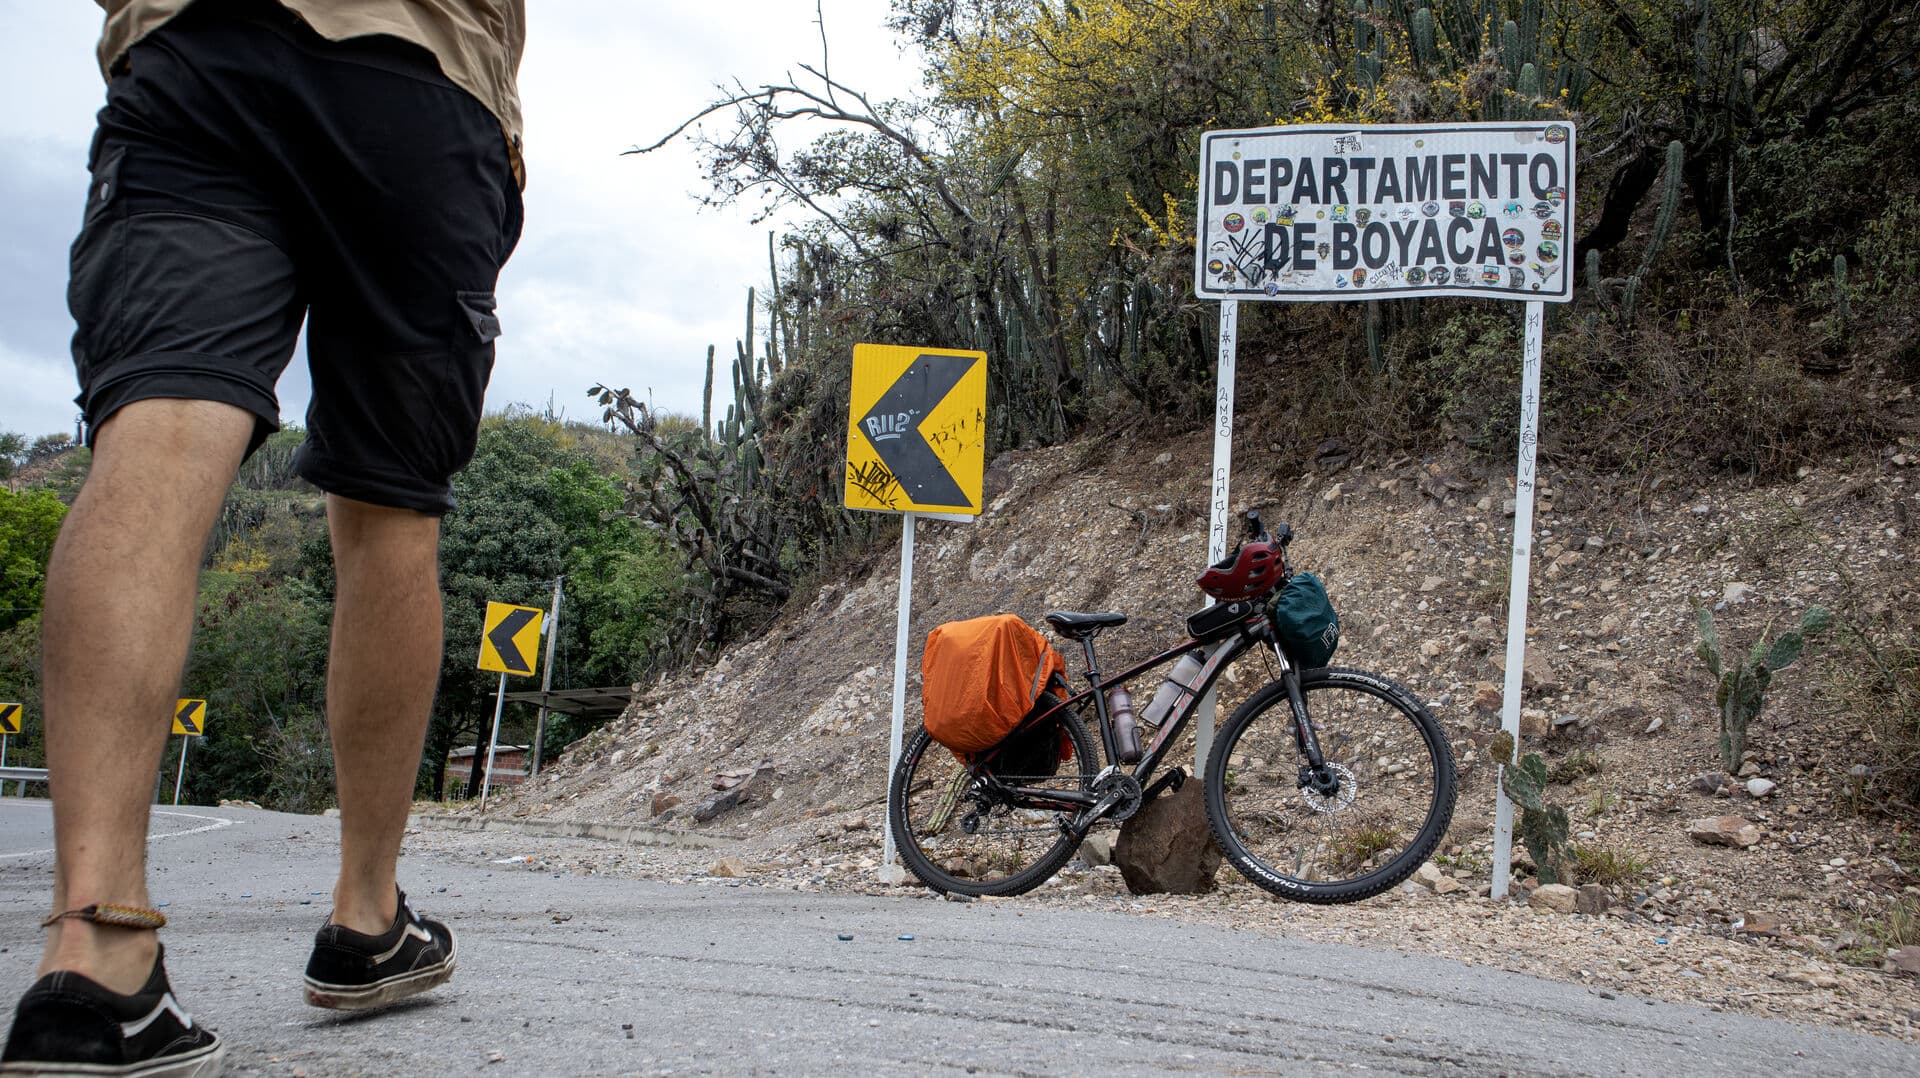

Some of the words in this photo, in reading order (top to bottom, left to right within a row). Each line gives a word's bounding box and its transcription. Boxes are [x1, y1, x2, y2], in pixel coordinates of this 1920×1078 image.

[1214, 153, 1559, 206] DEPARTAMENTO
[1264, 221, 1317, 270] DE
[1332, 216, 1506, 270] BOYACA
[1327, 672, 1391, 691] ZIPPERING
